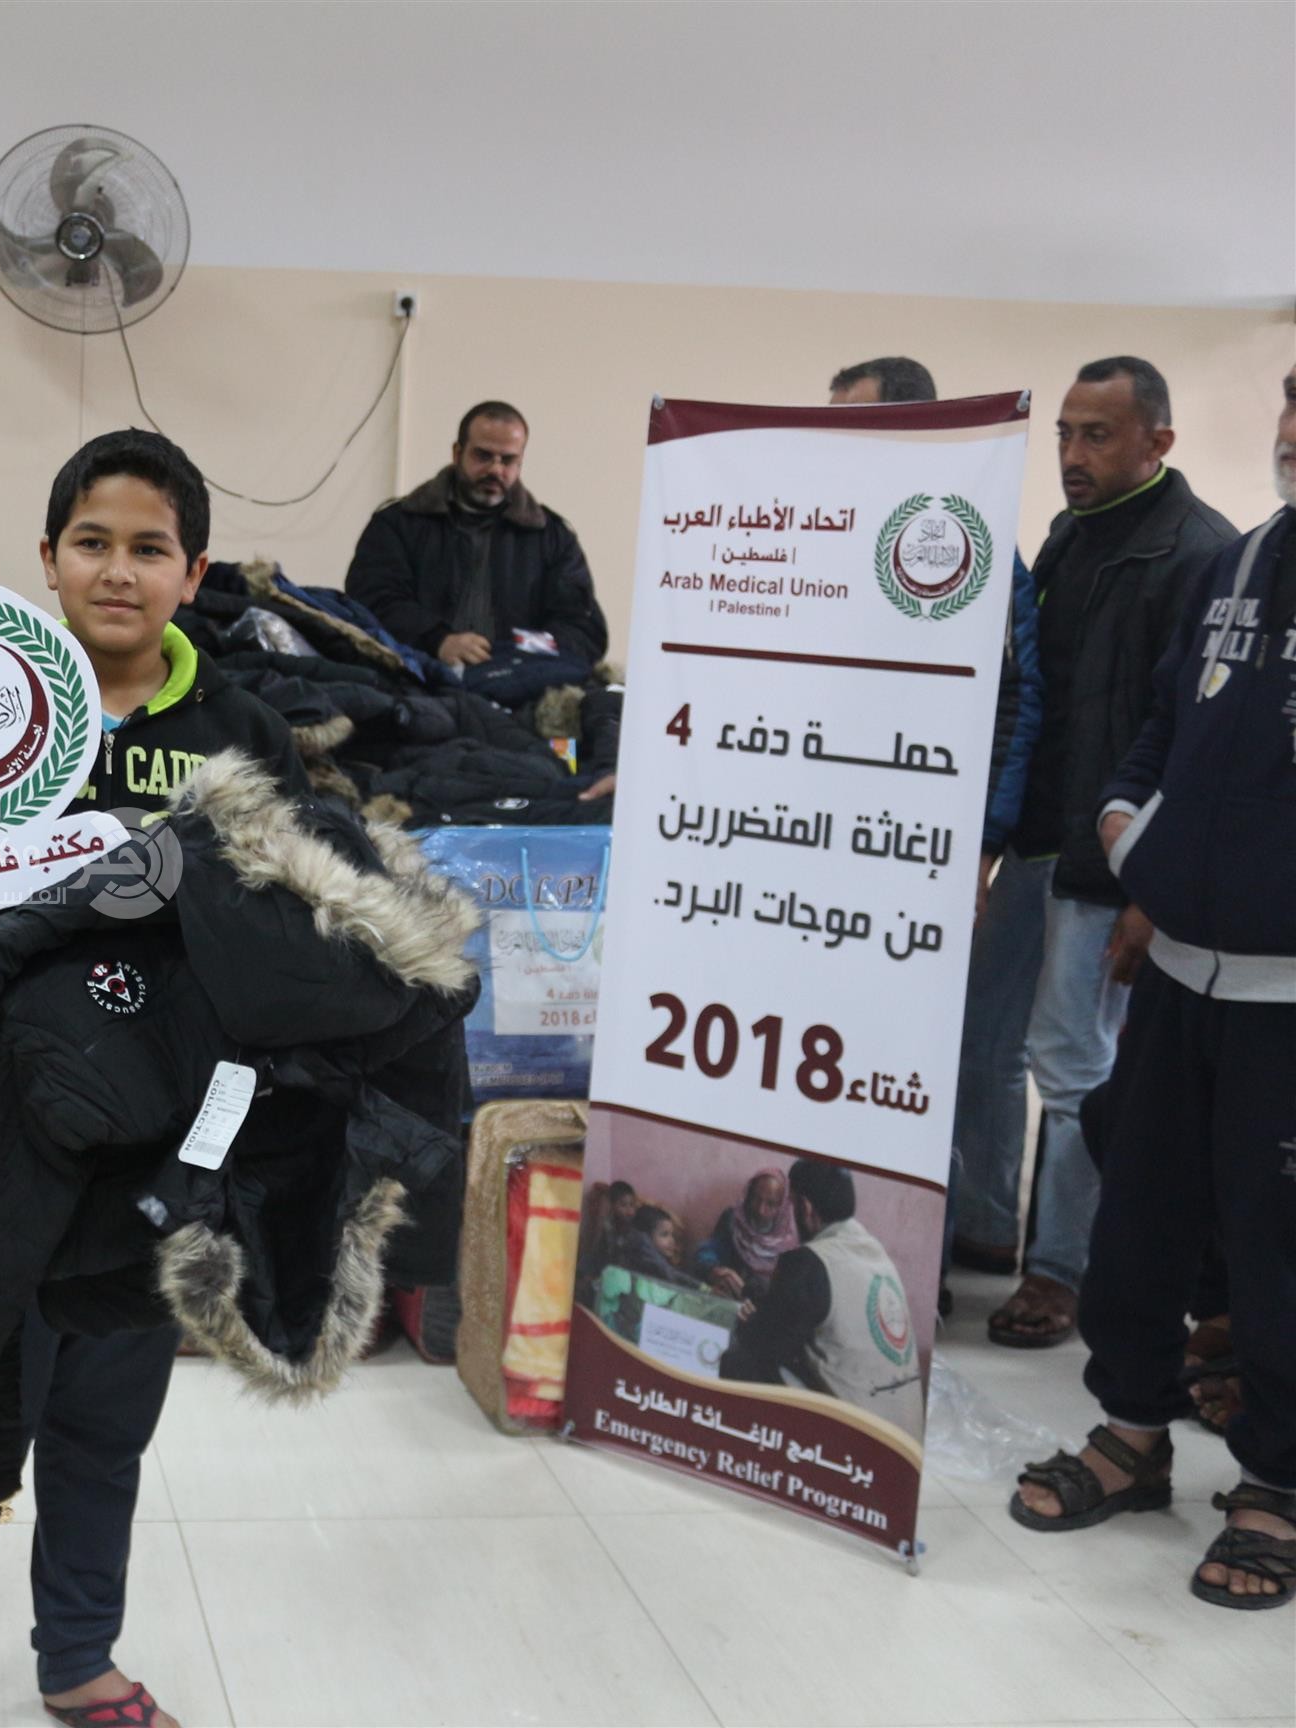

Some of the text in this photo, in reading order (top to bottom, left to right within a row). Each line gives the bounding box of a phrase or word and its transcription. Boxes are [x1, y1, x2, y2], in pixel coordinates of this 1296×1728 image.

[663, 498, 856, 536] اتحاد الأطباء العرب
[660, 571, 849, 599] Arab Medical Union
[665, 702, 959, 777] حملة دفء 4
[29, 830, 106, 875] مكتب
[658, 794, 953, 880] لإغاثة المتضررين
[753, 890, 872, 949] موجات
[884, 910, 944, 961] من
[540, 1010, 581, 1027] 2018
[644, 991, 845, 1104] 2018
[183, 1078, 221, 1152] COLLECTION
[594, 1408, 889, 1532] Emergency Relief Program
[785, 1440, 875, 1489] برنامج
